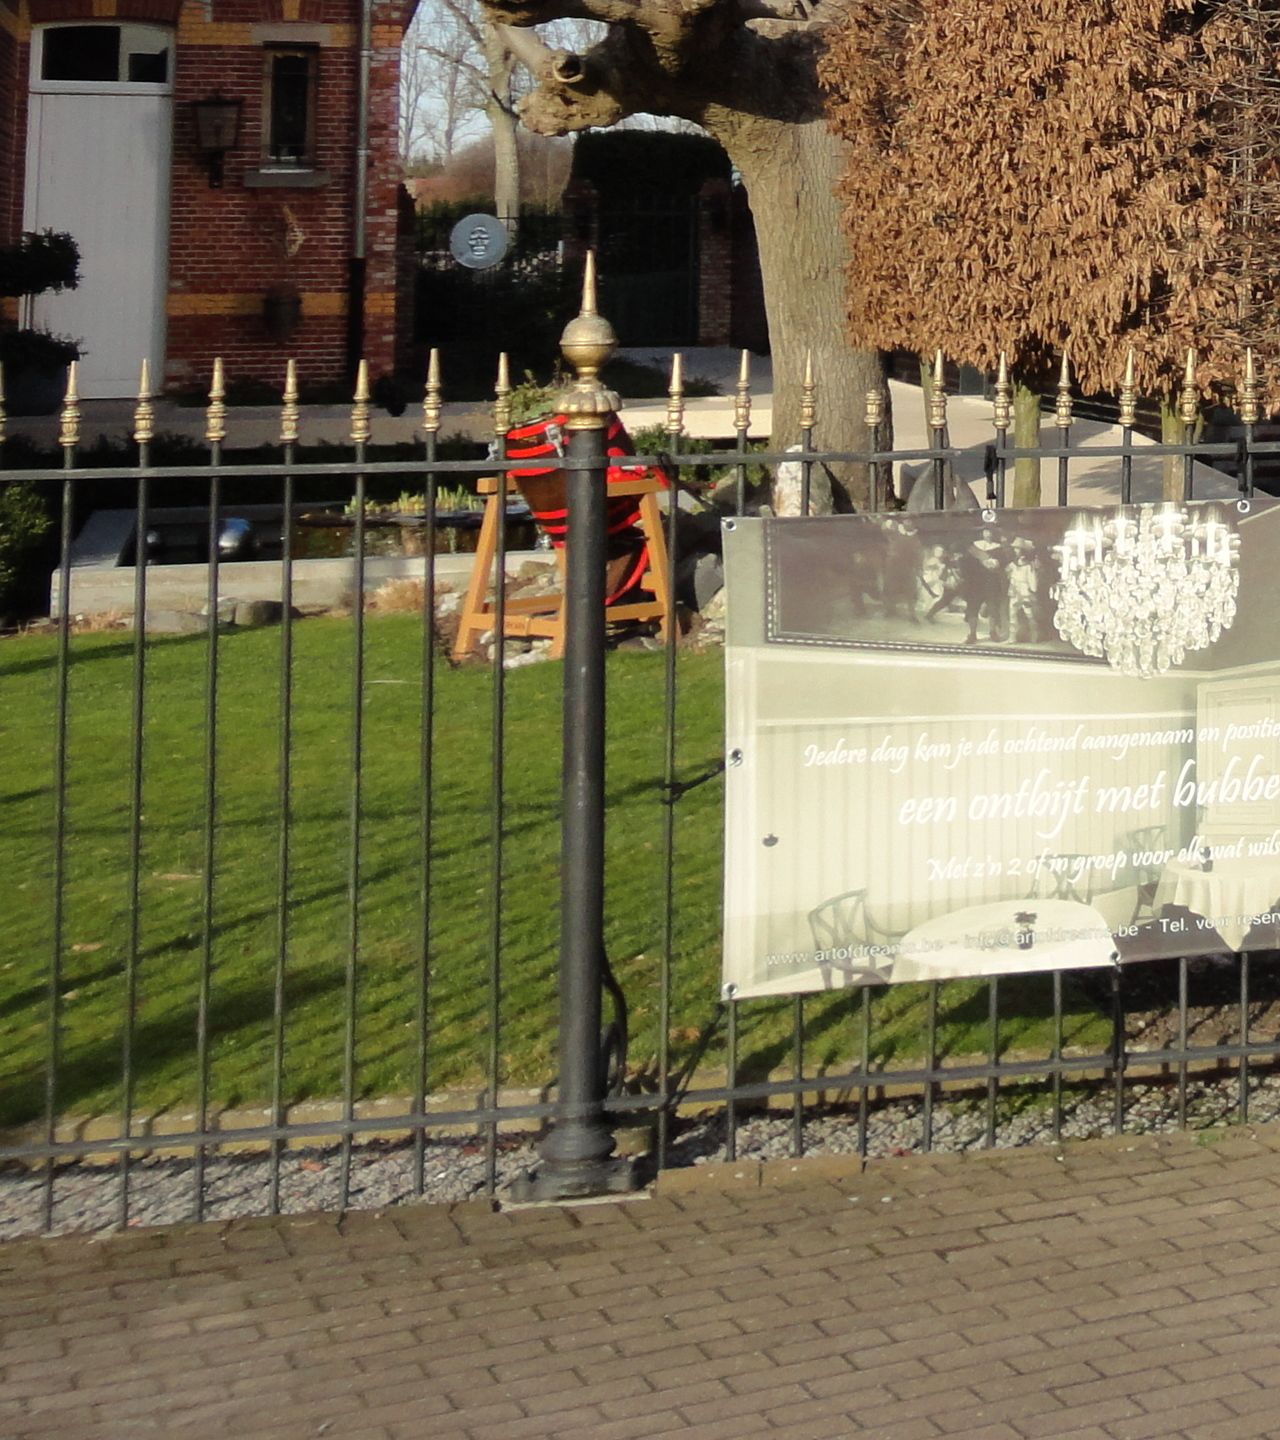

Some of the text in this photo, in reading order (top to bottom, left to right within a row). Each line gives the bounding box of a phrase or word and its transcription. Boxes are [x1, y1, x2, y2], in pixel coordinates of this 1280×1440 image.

[870, 735, 909, 773] dag
[914, 732, 951, 761] kan
[943, 737, 972, 769] je
[977, 728, 999, 755] de
[1003, 726, 1084, 754] ochtend
[1081, 728, 1193, 760] aangenaam
[1198, 725, 1220, 743] en
[899, 794, 957, 825] een
[968, 768, 1089, 839] ontbijt
[1096, 770, 1166, 813] met
[927, 856, 971, 881] Met
[1006, 858, 1022, 877] 2
[1026, 847, 1051, 880] of
[1049, 854, 1068, 874] in
[1067, 850, 1127, 883] groep
[1131, 850, 1174, 867] voor
[1177, 835, 1208, 864] elk
[1210, 840, 1244, 860] wat
[1160, 918, 1189, 934] Tel.
[1195, 916, 1229, 931] voor
